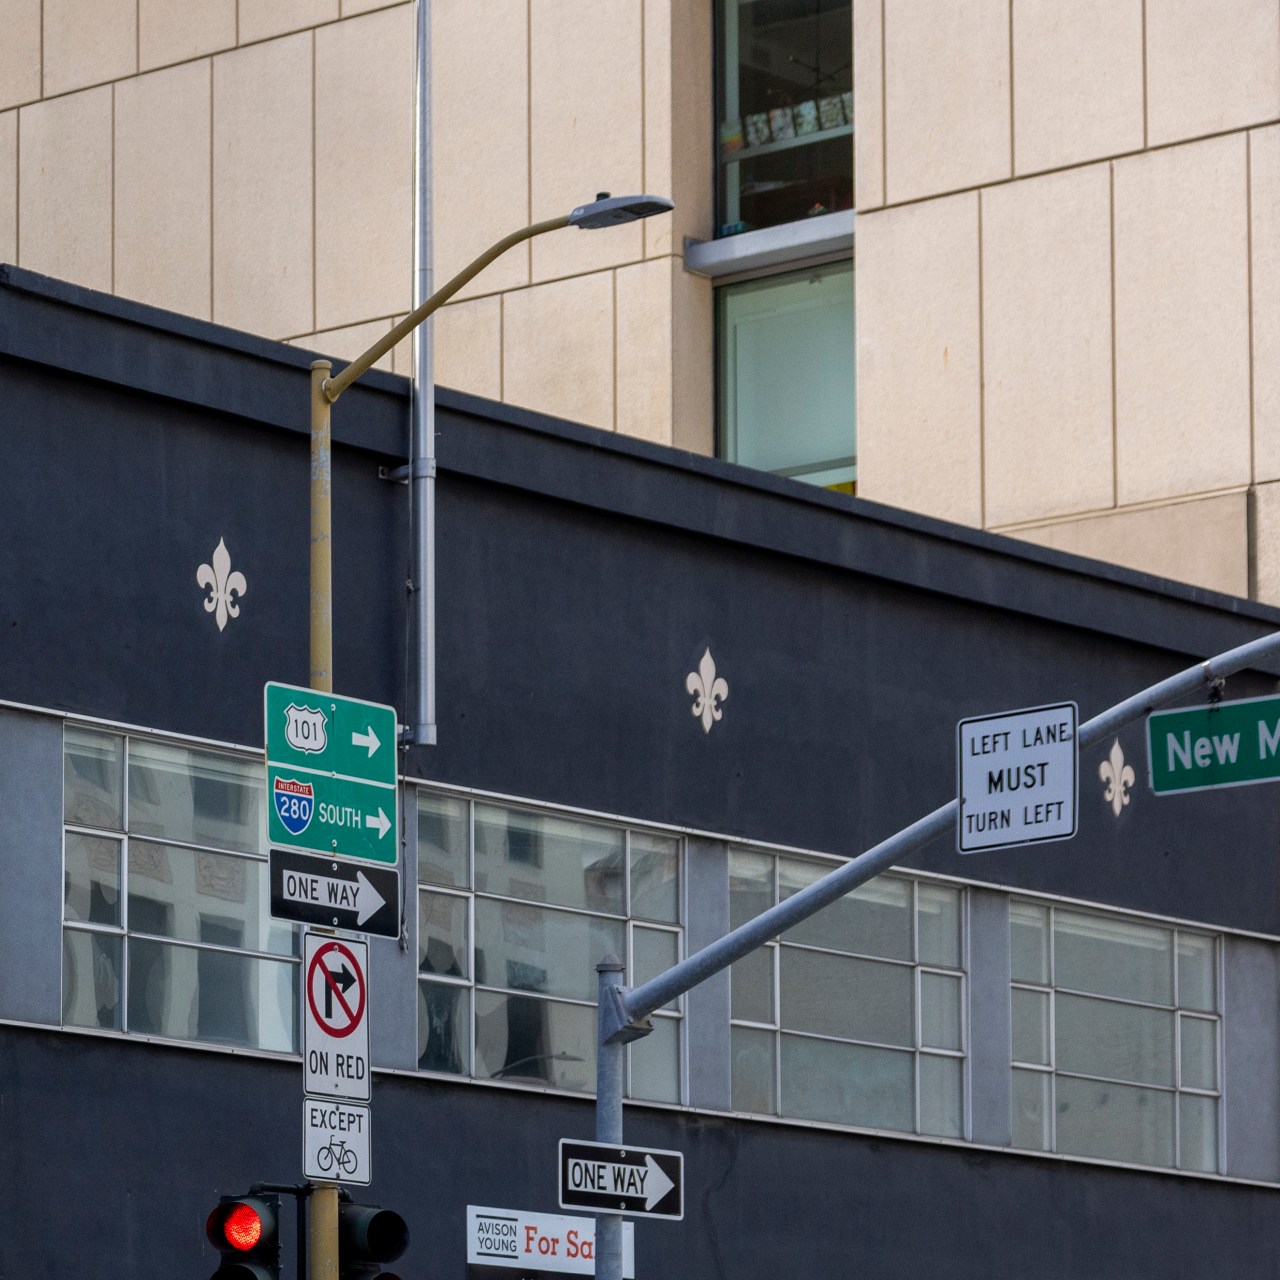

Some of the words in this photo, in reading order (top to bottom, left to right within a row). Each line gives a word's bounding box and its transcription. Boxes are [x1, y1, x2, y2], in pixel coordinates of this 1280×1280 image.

[294, 719, 317, 741] 101
[971, 732, 1011, 756] LEFT
[1023, 722, 1068, 748] LANE
[1166, 730, 1240, 771] New
[1258, 717, 1280, 760] M
[278, 782, 310, 795] INTERSTATE
[988, 762, 1049, 794] MUST
[280, 796, 310, 821] 280
[318, 803, 362, 829] SOUTH
[967, 809, 1010, 833] TURN
[1024, 801, 1064, 825] LEFT
[287, 875, 319, 901] ONE
[327, 882, 360, 907] WAY
[310, 1050, 328, 1076] ON
[336, 1054, 365, 1080] RED
[311, 1108, 363, 1133] EXCEPT
[572, 1161, 607, 1190] ONE
[613, 1166, 648, 1195] WAY
[478, 1222, 517, 1237] AVISON
[478, 1237, 517, 1252] YOUNG
[524, 1226, 559, 1255] For
[567, 1230, 596, 1259] Sa
